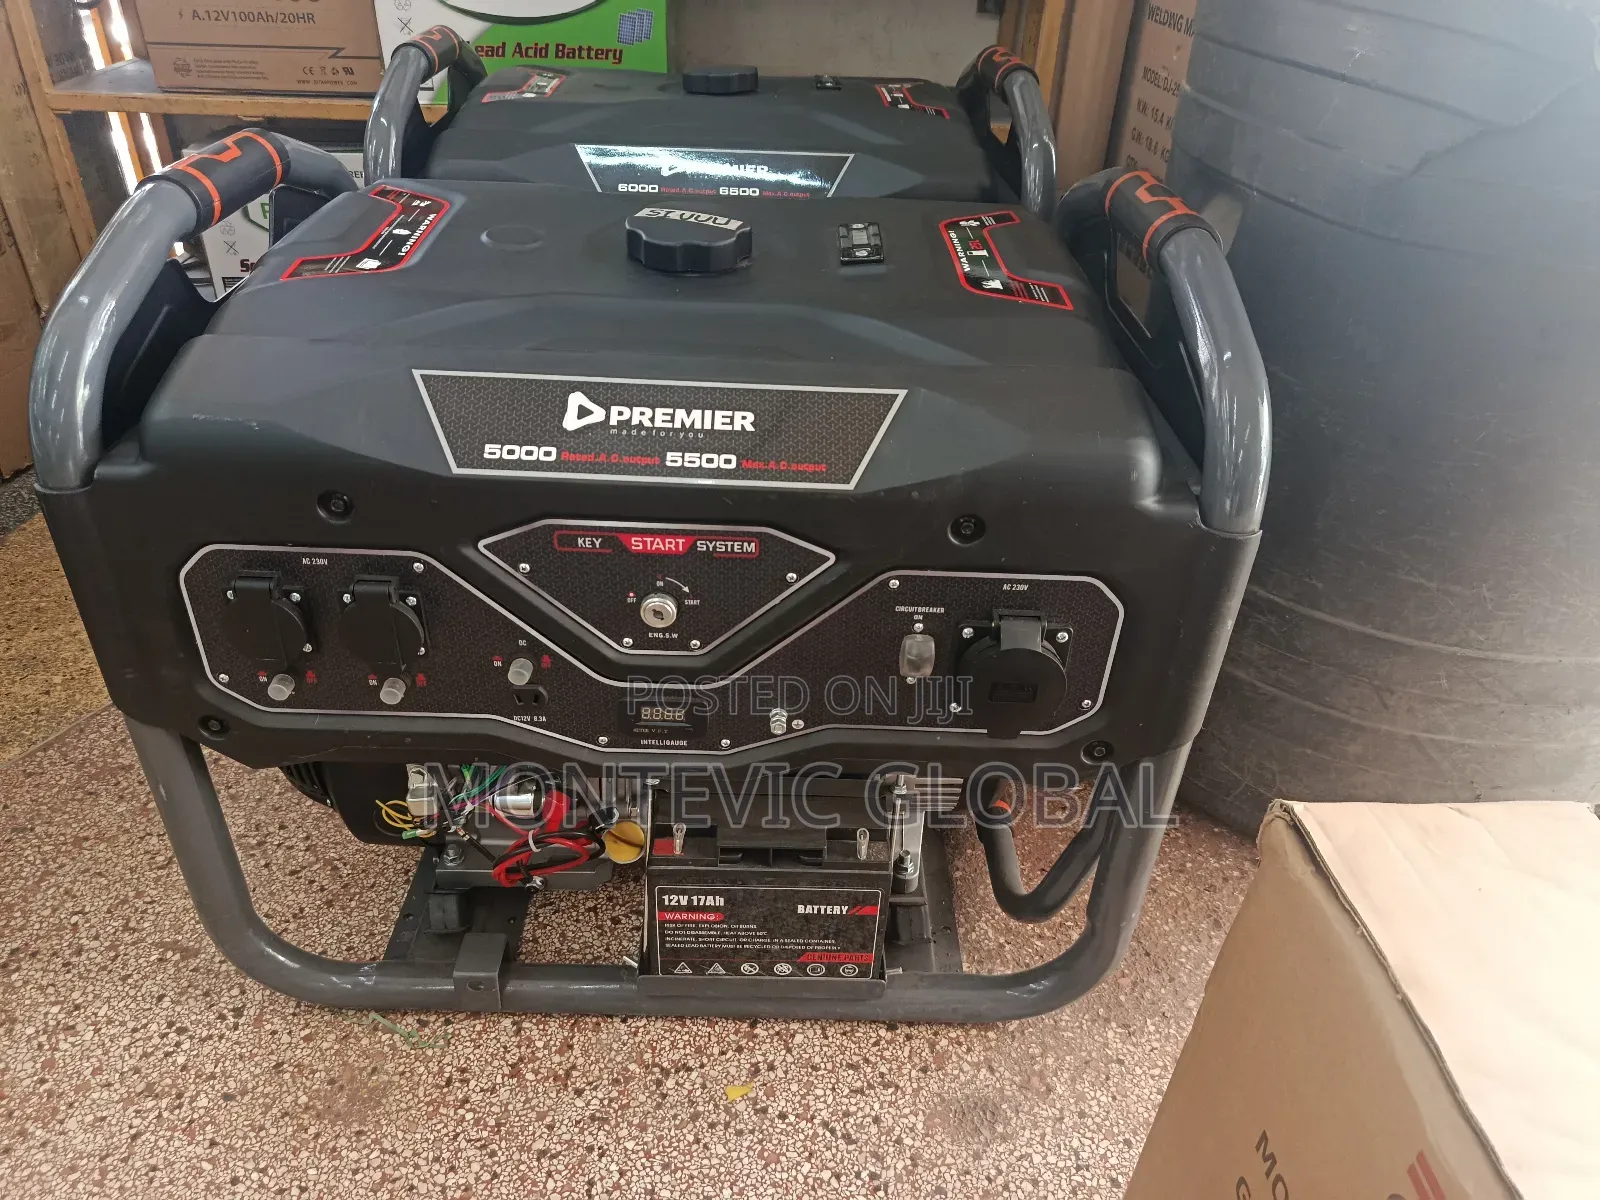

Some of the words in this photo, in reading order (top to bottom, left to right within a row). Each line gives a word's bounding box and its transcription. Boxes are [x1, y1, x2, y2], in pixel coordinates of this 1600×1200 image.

[192, 9, 316, 25] A.12V100Ah/20HR
[1147, 3, 1184, 33] WELDING
[474, 42, 507, 59] ead
[512, 42, 550, 59] Acid
[554, 43, 624, 65] Battery
[618, 184, 659, 193] 6000
[719, 187, 760, 196] 6500
[398, 213, 437, 256] WARNING!
[948, 230, 971, 272] WARNING!
[609, 405, 756, 432] PREMIER
[483, 443, 557, 462] 5000
[665, 451, 737, 469] 5500
[577, 537, 602, 549] KEY
[631, 537, 686, 552] START
[696, 541, 756, 553] SYSTEM
[1011, 583, 1029, 591] 230V
[662, 894, 689, 906] 12V
[691, 894, 725, 907] 17Ah
[797, 904, 849, 915] BATTERY
